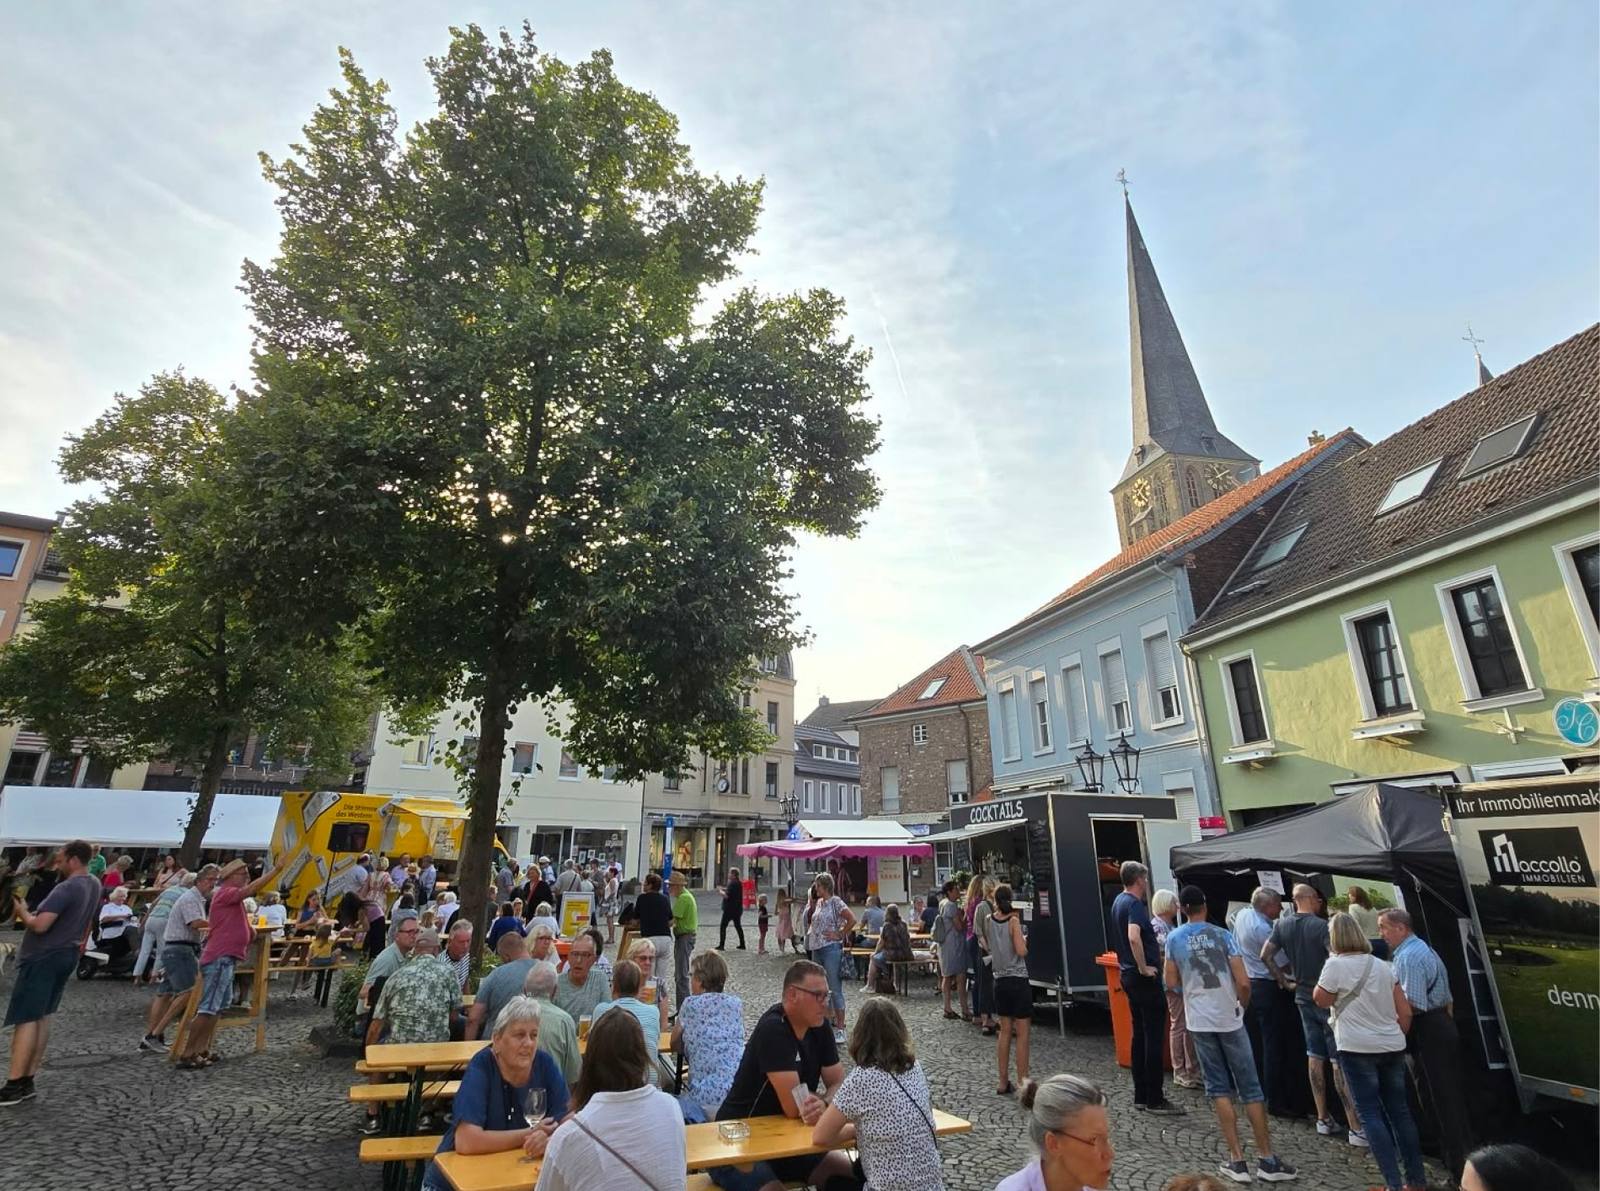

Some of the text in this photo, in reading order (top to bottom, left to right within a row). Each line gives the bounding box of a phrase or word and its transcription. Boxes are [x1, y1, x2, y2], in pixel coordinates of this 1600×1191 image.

[970, 801, 1024, 823] COCKTAILS
[1456, 798, 1475, 813] Ihr
[1522, 874, 1586, 884] IMMOBILIEN
